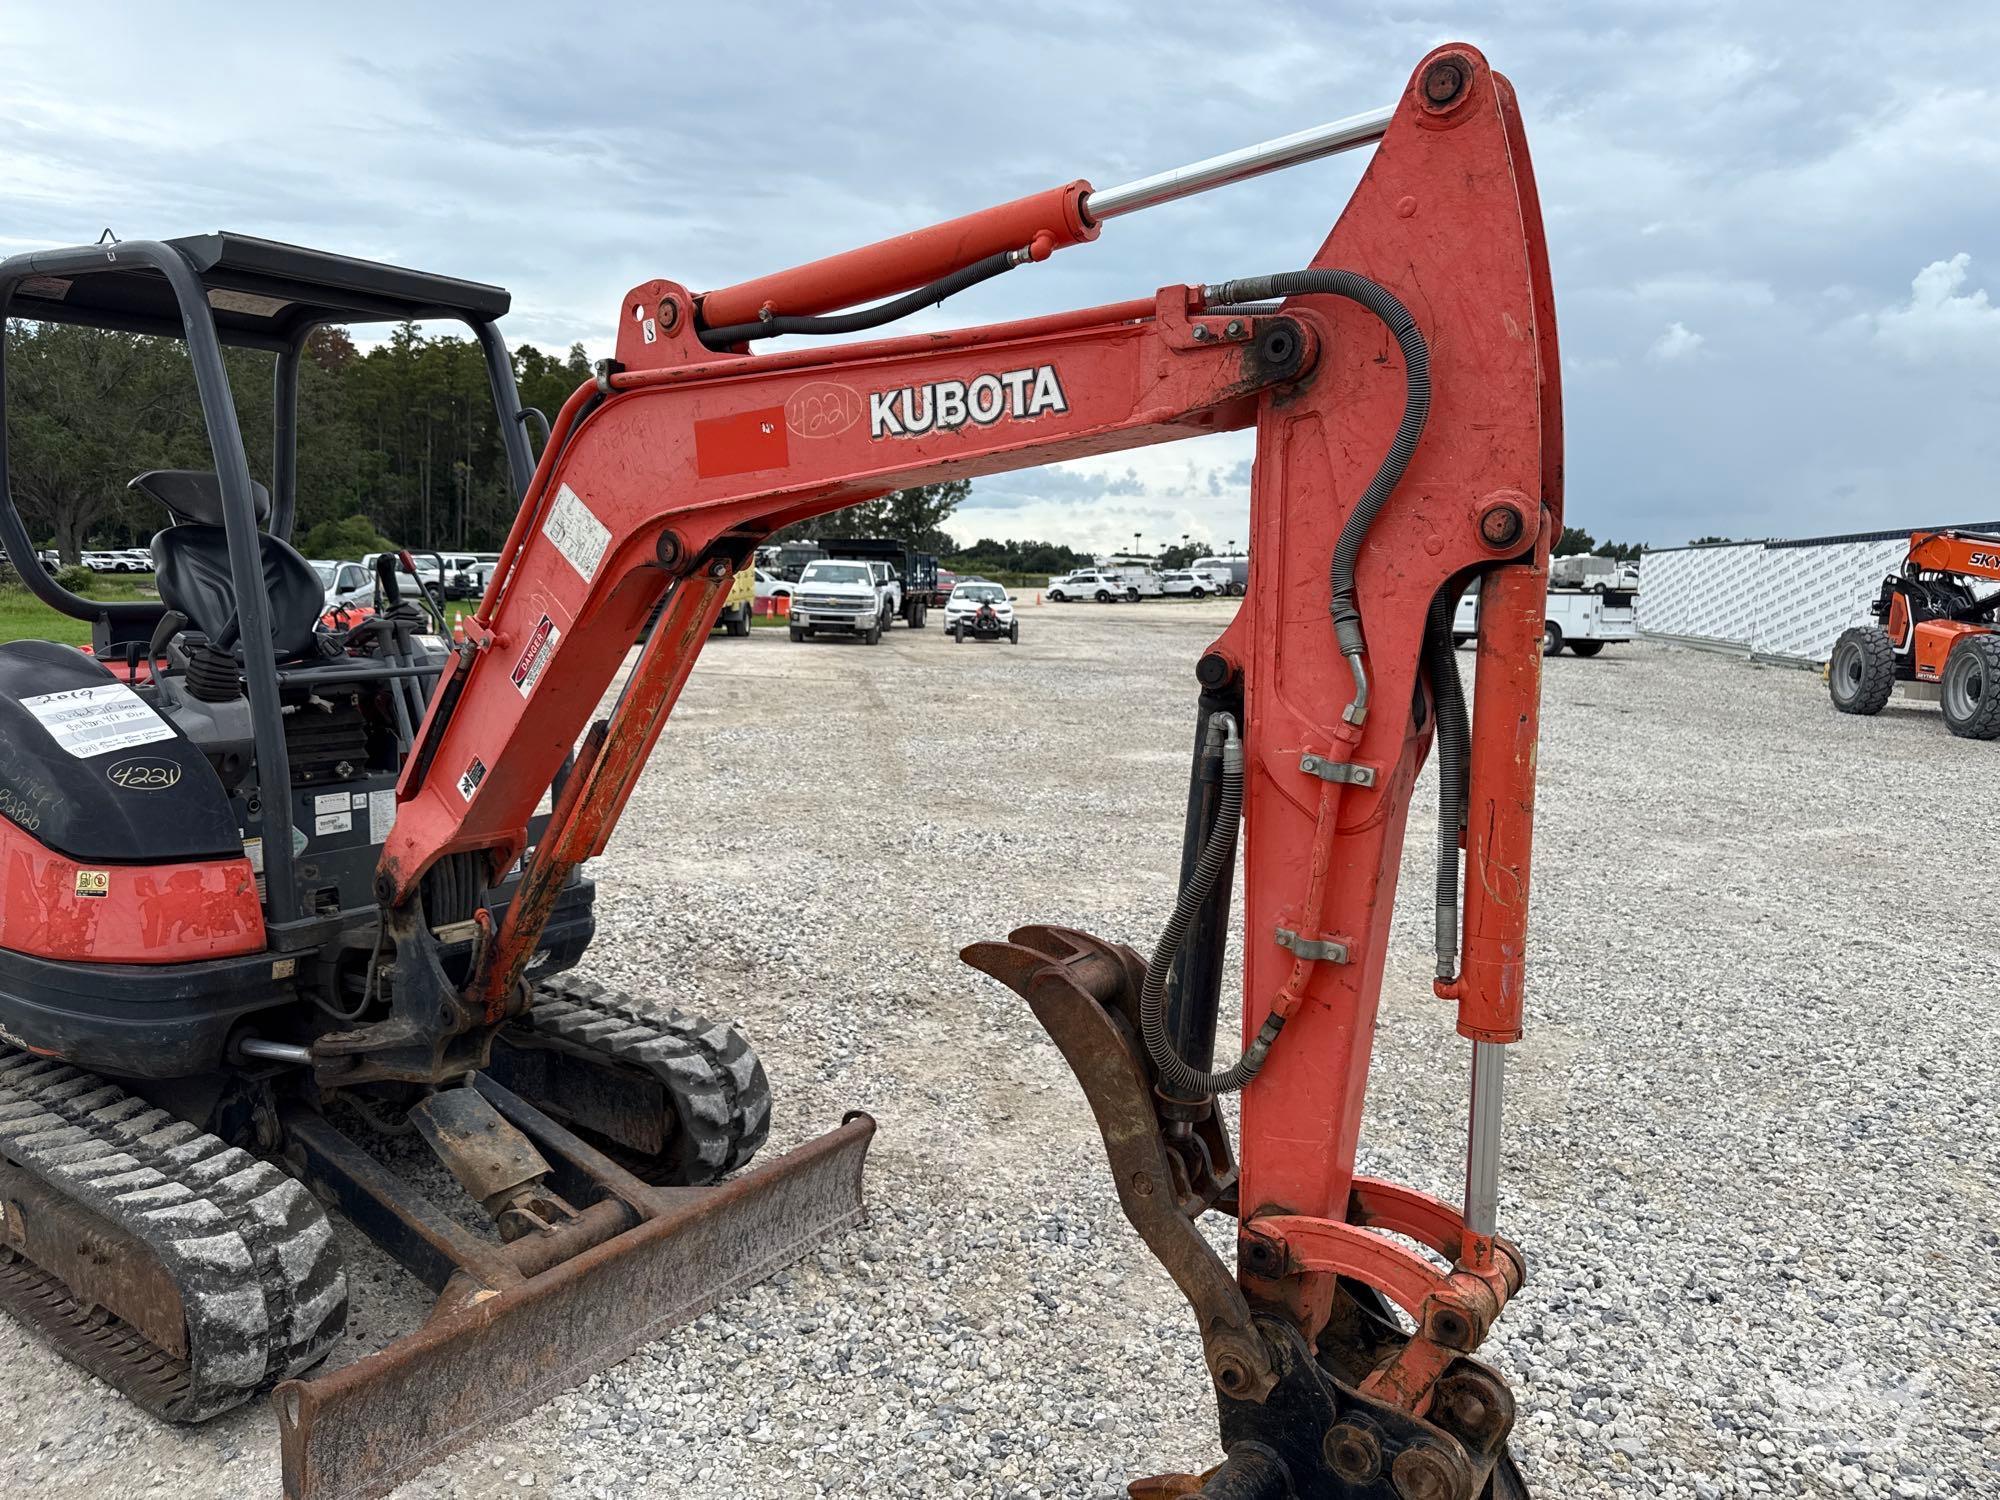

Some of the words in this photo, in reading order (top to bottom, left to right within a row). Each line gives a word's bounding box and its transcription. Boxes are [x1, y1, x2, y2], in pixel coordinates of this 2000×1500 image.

[791, 391, 850, 439] 4221
[870, 365, 1067, 438] KUBOTA
[521, 635, 544, 671] DANGER
[36, 690, 94, 704] 2019
[112, 766, 176, 787] 4221
